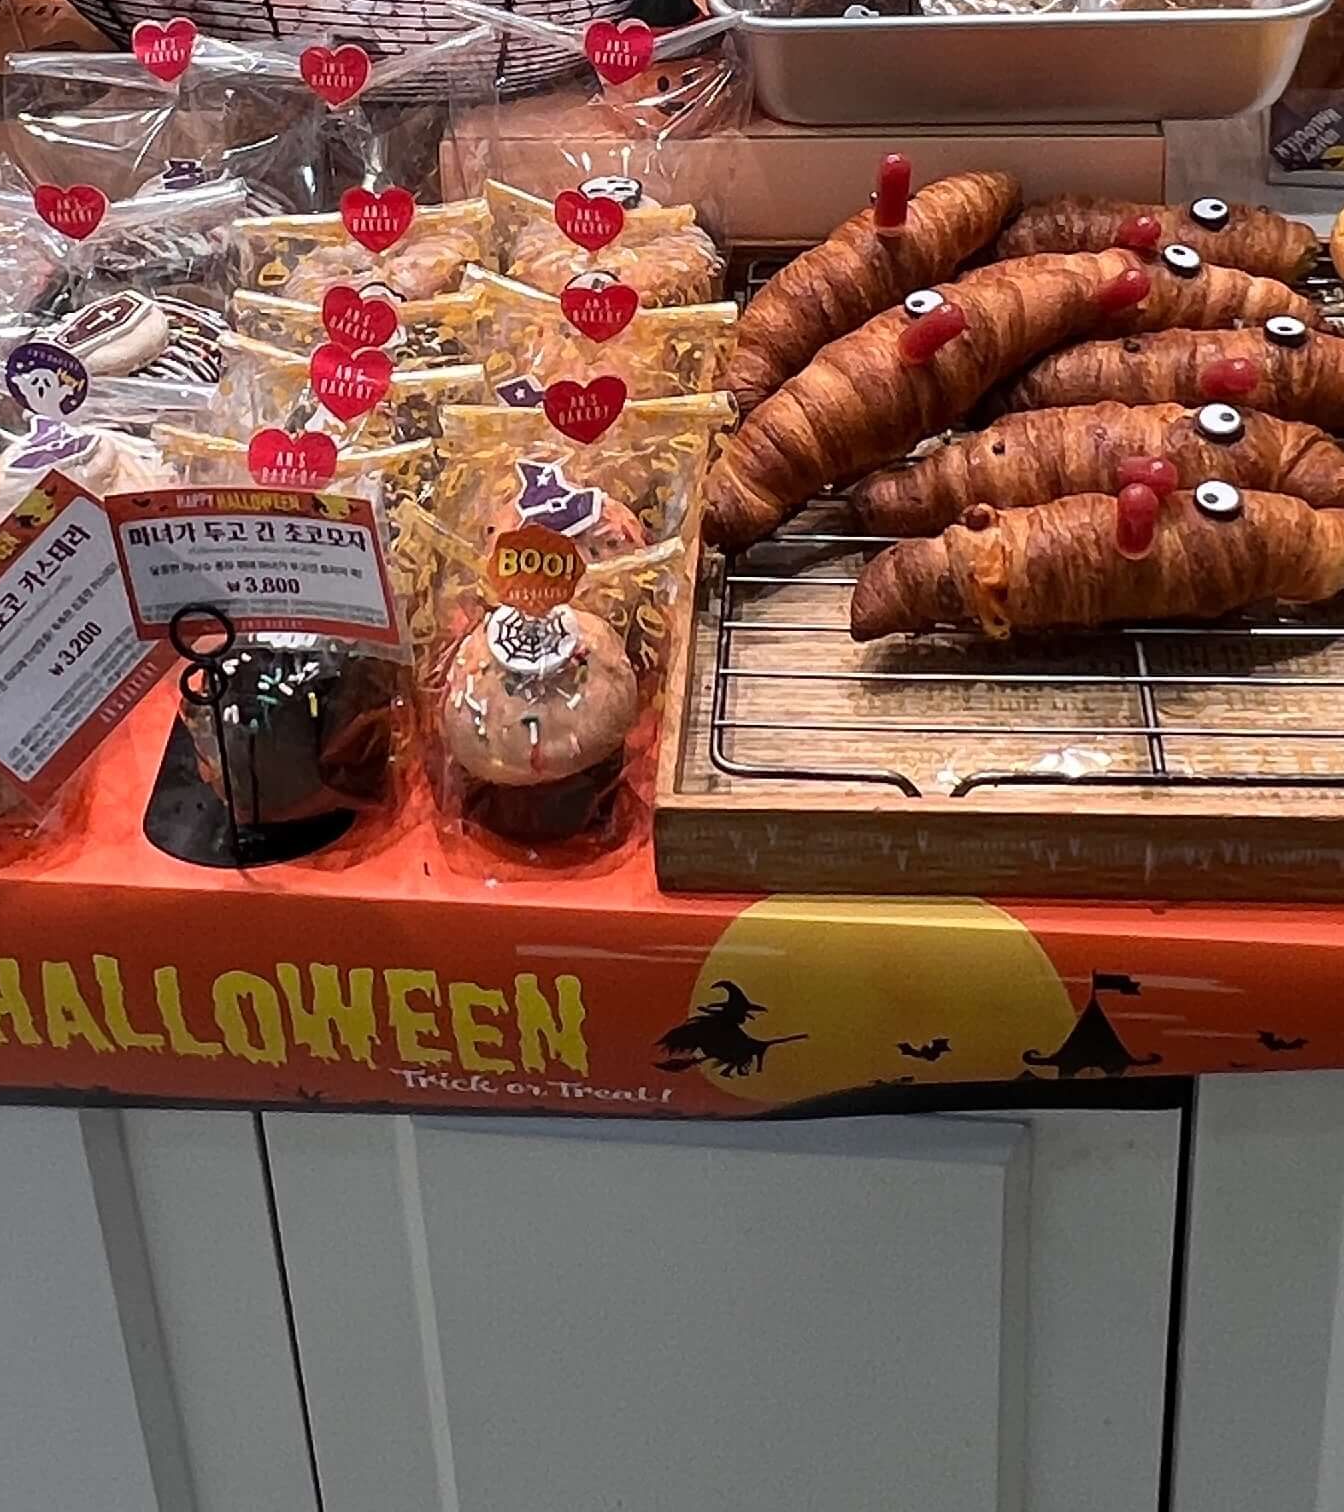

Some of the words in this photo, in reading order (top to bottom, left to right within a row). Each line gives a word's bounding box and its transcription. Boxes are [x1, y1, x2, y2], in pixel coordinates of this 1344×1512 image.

[205, 522, 249, 542] 두고
[254, 522, 276, 542] 간
[284, 522, 367, 553] 초코모자
[16, 523, 93, 594] 카스테라
[498, 548, 575, 581] BOO!
[389, 1066, 499, 1093] Trick
[506, 1079, 542, 1096] or
[540, 1079, 674, 1103] Treat!
